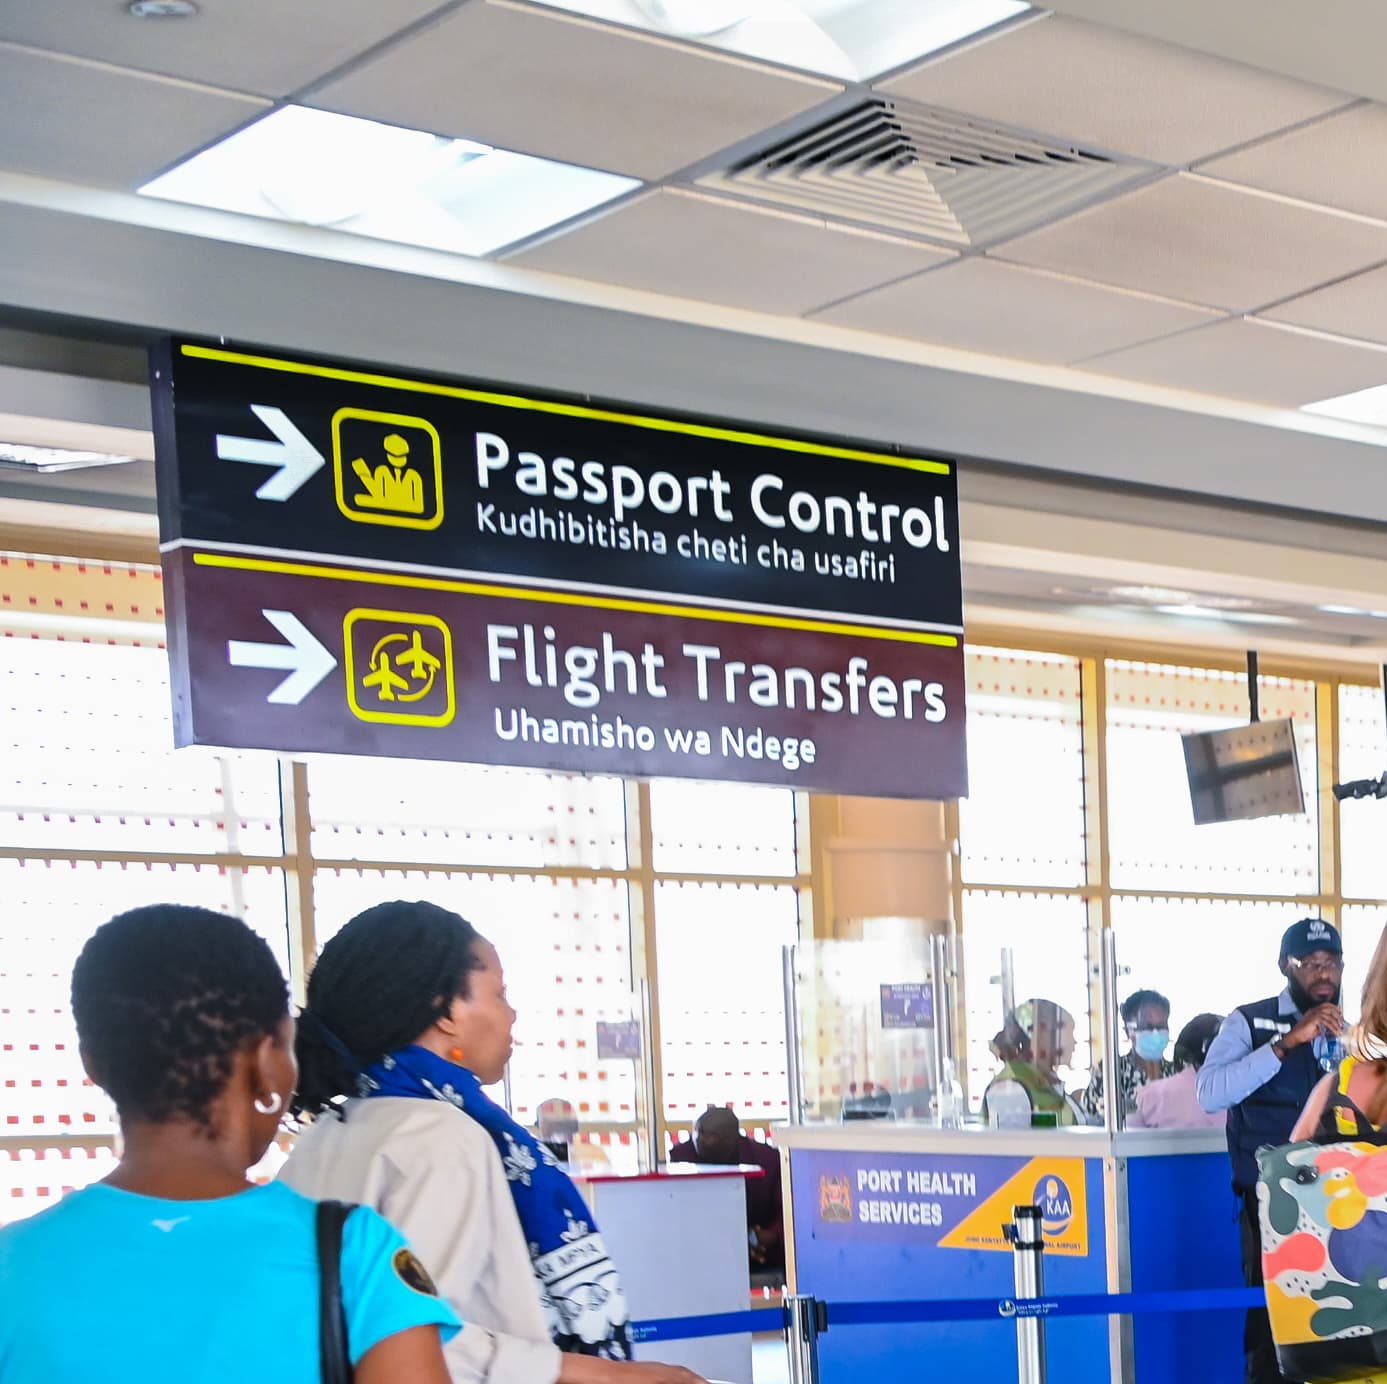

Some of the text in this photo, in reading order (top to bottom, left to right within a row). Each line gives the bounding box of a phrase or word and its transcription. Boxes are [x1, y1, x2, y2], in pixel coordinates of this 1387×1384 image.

[475, 432, 951, 552] Passport Control
[477, 502, 896, 583] Kudhibitisha cheti cha usafiri
[486, 623, 947, 723] Flight Transfers
[493, 708, 816, 771] Uhamisho wa Ndege
[857, 1169, 976, 1196] PORT HEALTH
[858, 1202, 942, 1226] SERVICES
[1046, 1197, 1071, 1217] KAA
